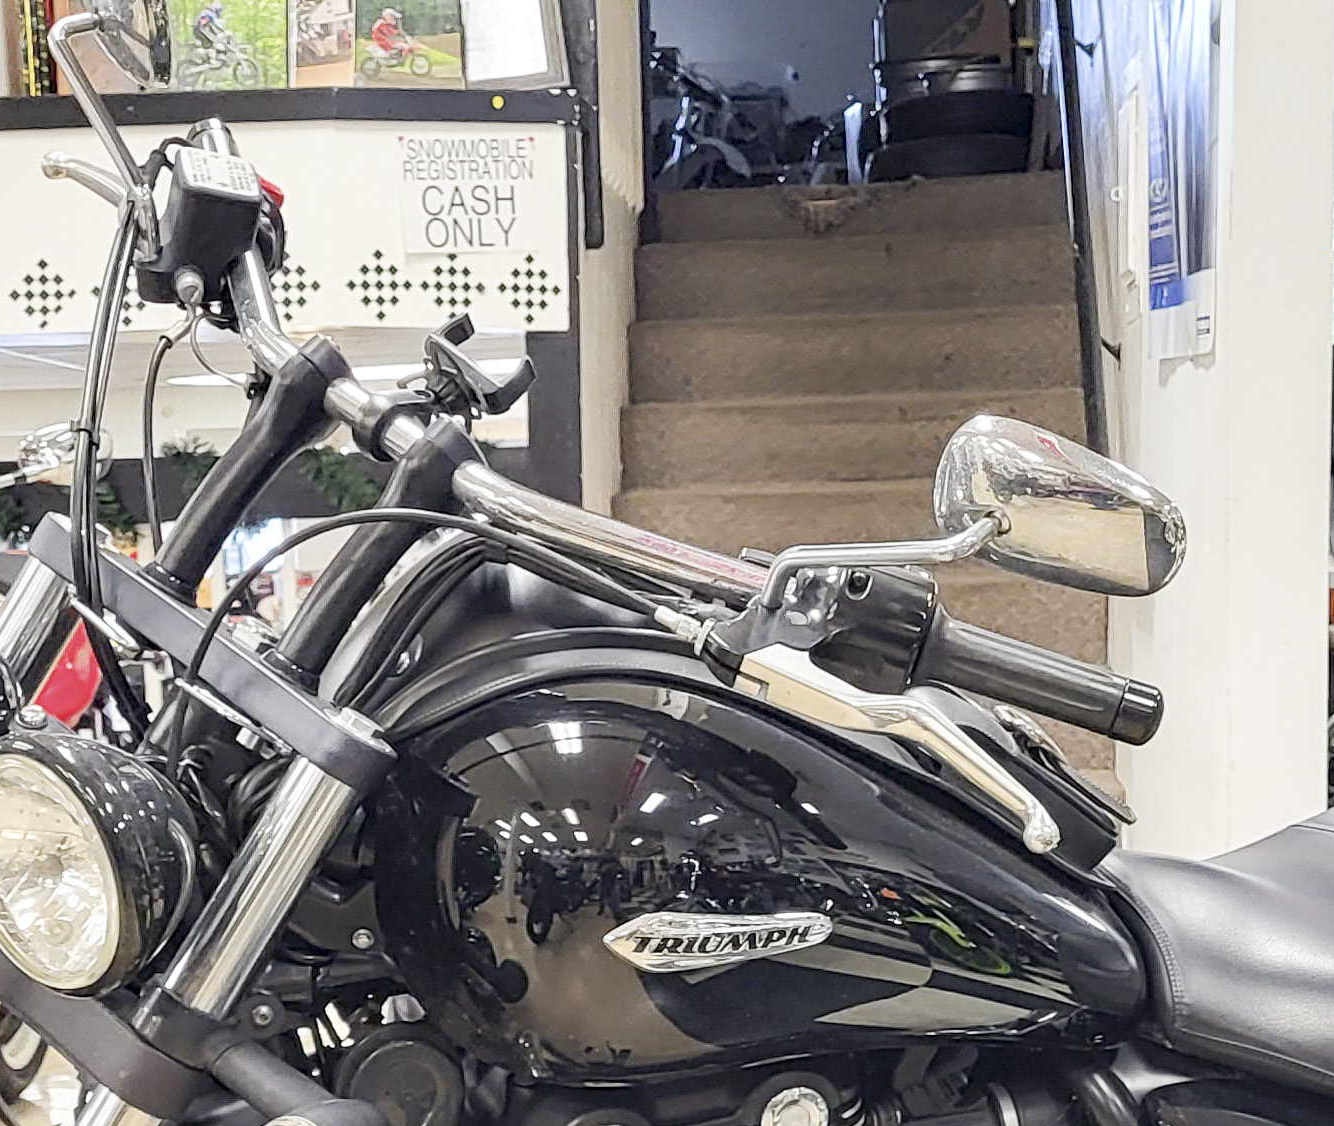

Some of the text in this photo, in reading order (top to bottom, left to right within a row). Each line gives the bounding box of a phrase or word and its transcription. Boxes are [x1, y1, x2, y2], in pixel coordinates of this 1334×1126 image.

[405, 138, 529, 160] SNOWMOBILE
[402, 159, 534, 181] REGISTRATION
[422, 184, 516, 216] CASH
[425, 217, 517, 248] ONLY
[632, 925, 811, 954] TRIUMPH
